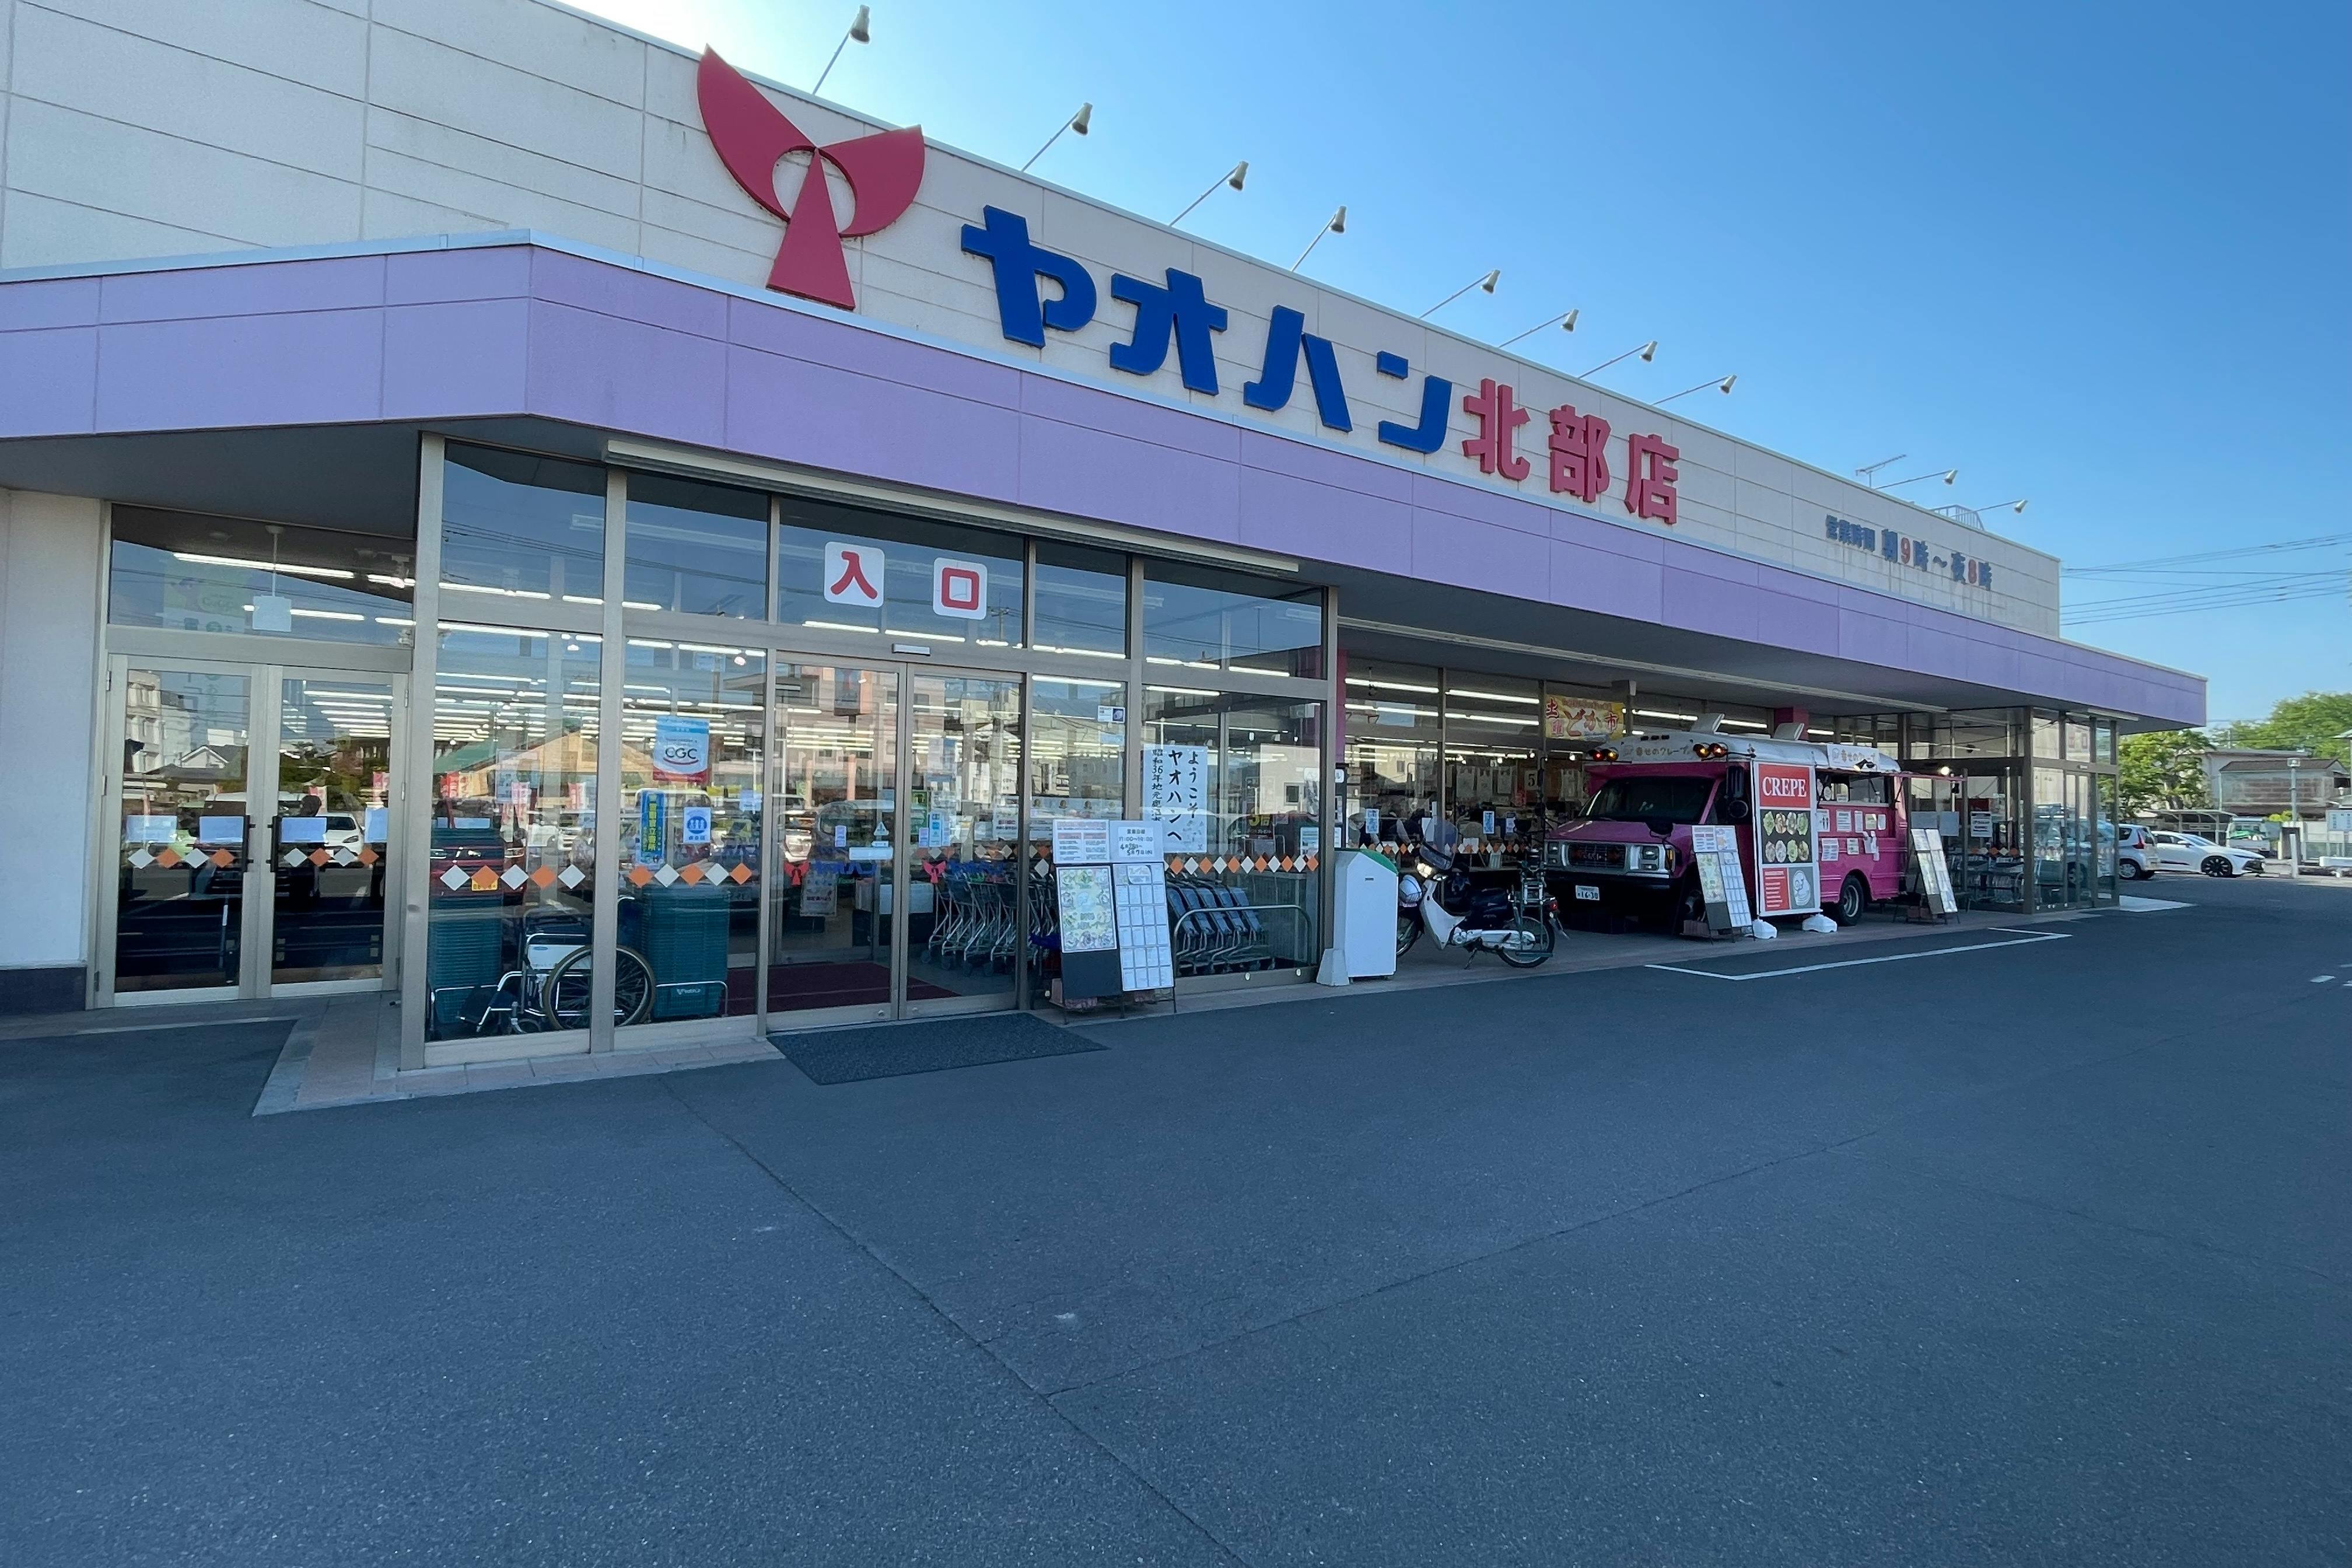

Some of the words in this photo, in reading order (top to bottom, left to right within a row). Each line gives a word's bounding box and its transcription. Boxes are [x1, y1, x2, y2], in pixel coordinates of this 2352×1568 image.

[830, 551, 979, 610] 入口
[665, 747, 698, 759] CGC
[1167, 750, 1183, 841] ヤオハンへ
[1187, 750, 1199, 818] ようこそ
[1762, 776, 1807, 797] CREPE
